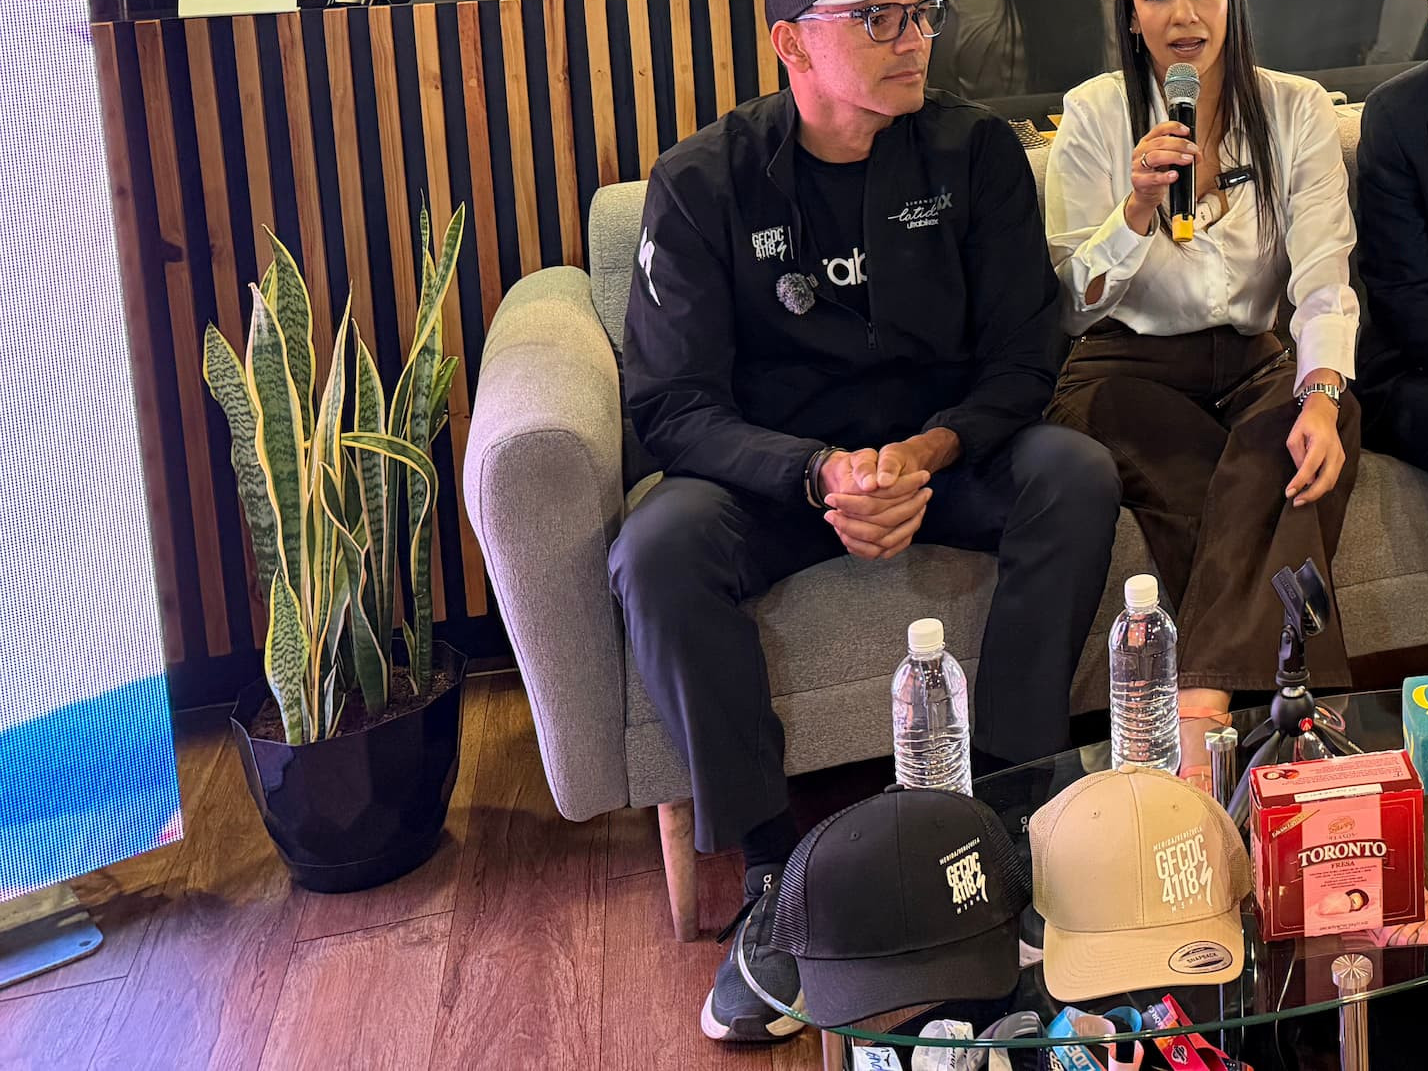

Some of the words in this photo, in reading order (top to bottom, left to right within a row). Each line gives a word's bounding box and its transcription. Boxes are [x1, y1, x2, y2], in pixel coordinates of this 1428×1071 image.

[1155, 833, 1205, 880] GFCDC
[1298, 841, 1388, 867] TORONTO
[1331, 861, 1356, 870] FRESA
[952, 875, 978, 905] 4118
[1162, 867, 1201, 905] 4118
